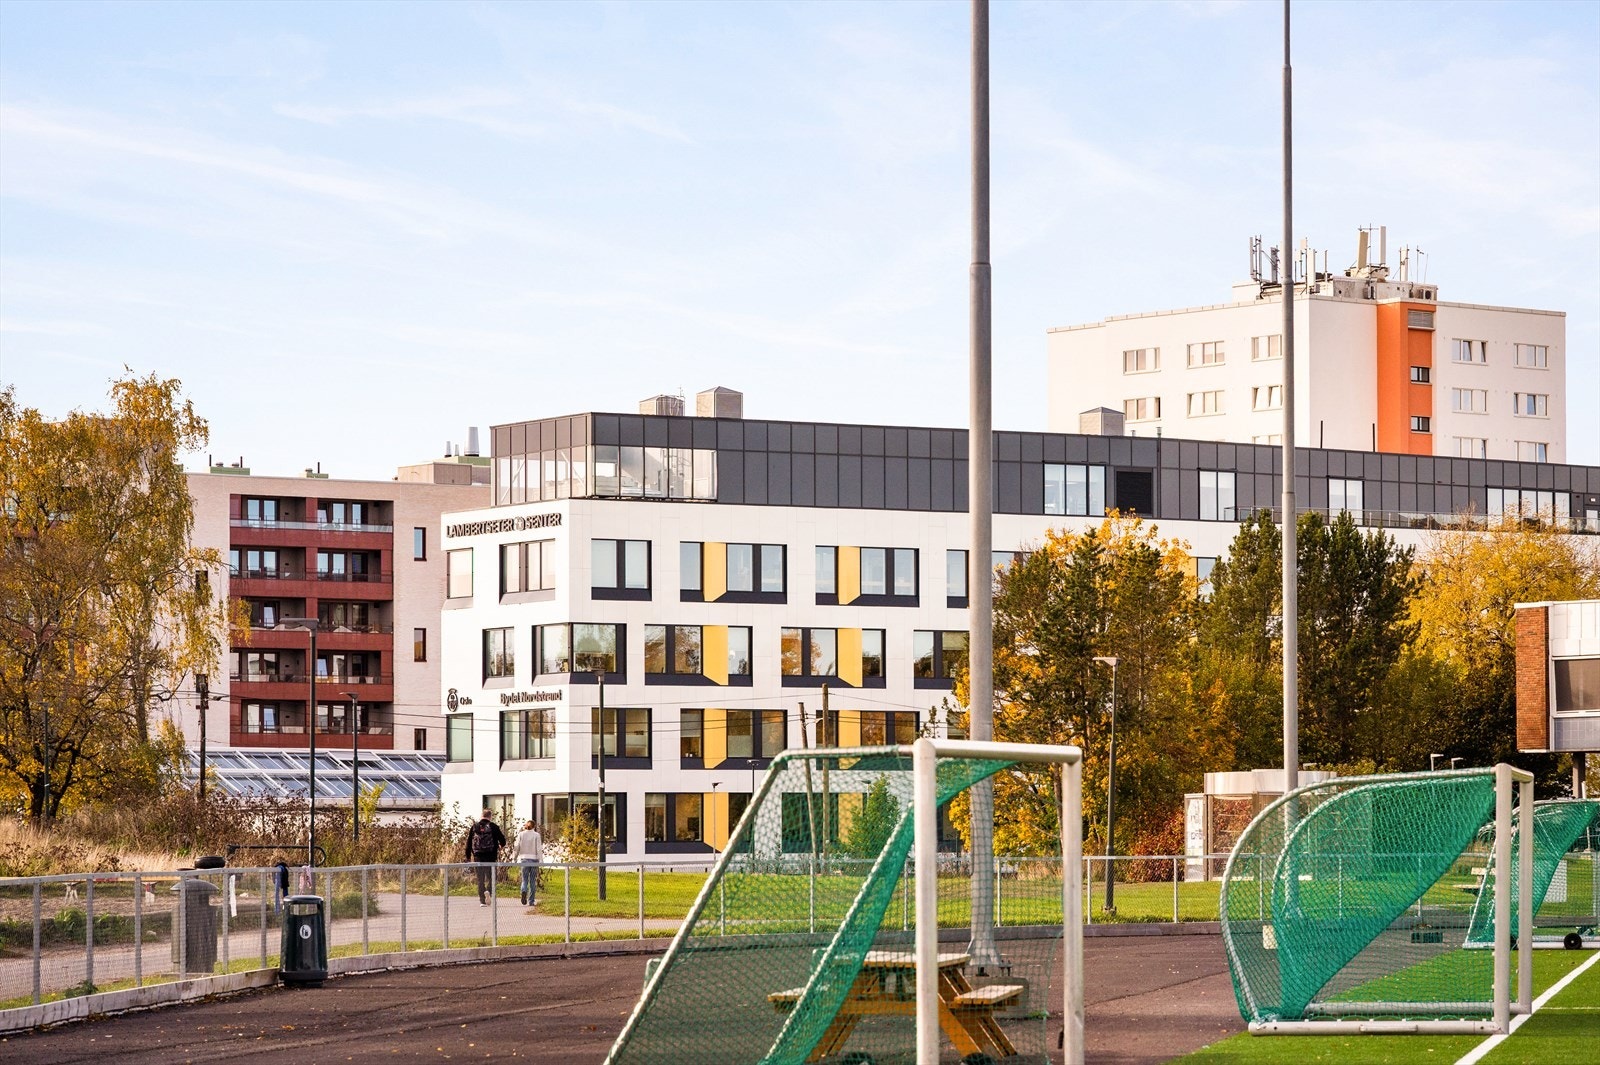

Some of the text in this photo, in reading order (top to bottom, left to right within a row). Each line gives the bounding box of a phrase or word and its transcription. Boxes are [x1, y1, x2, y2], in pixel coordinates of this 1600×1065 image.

[446, 513, 562, 538] LAMBERTSETER SENTER
[460, 696, 472, 705] Oslo
[521, 689, 562, 703] Nordstrand
